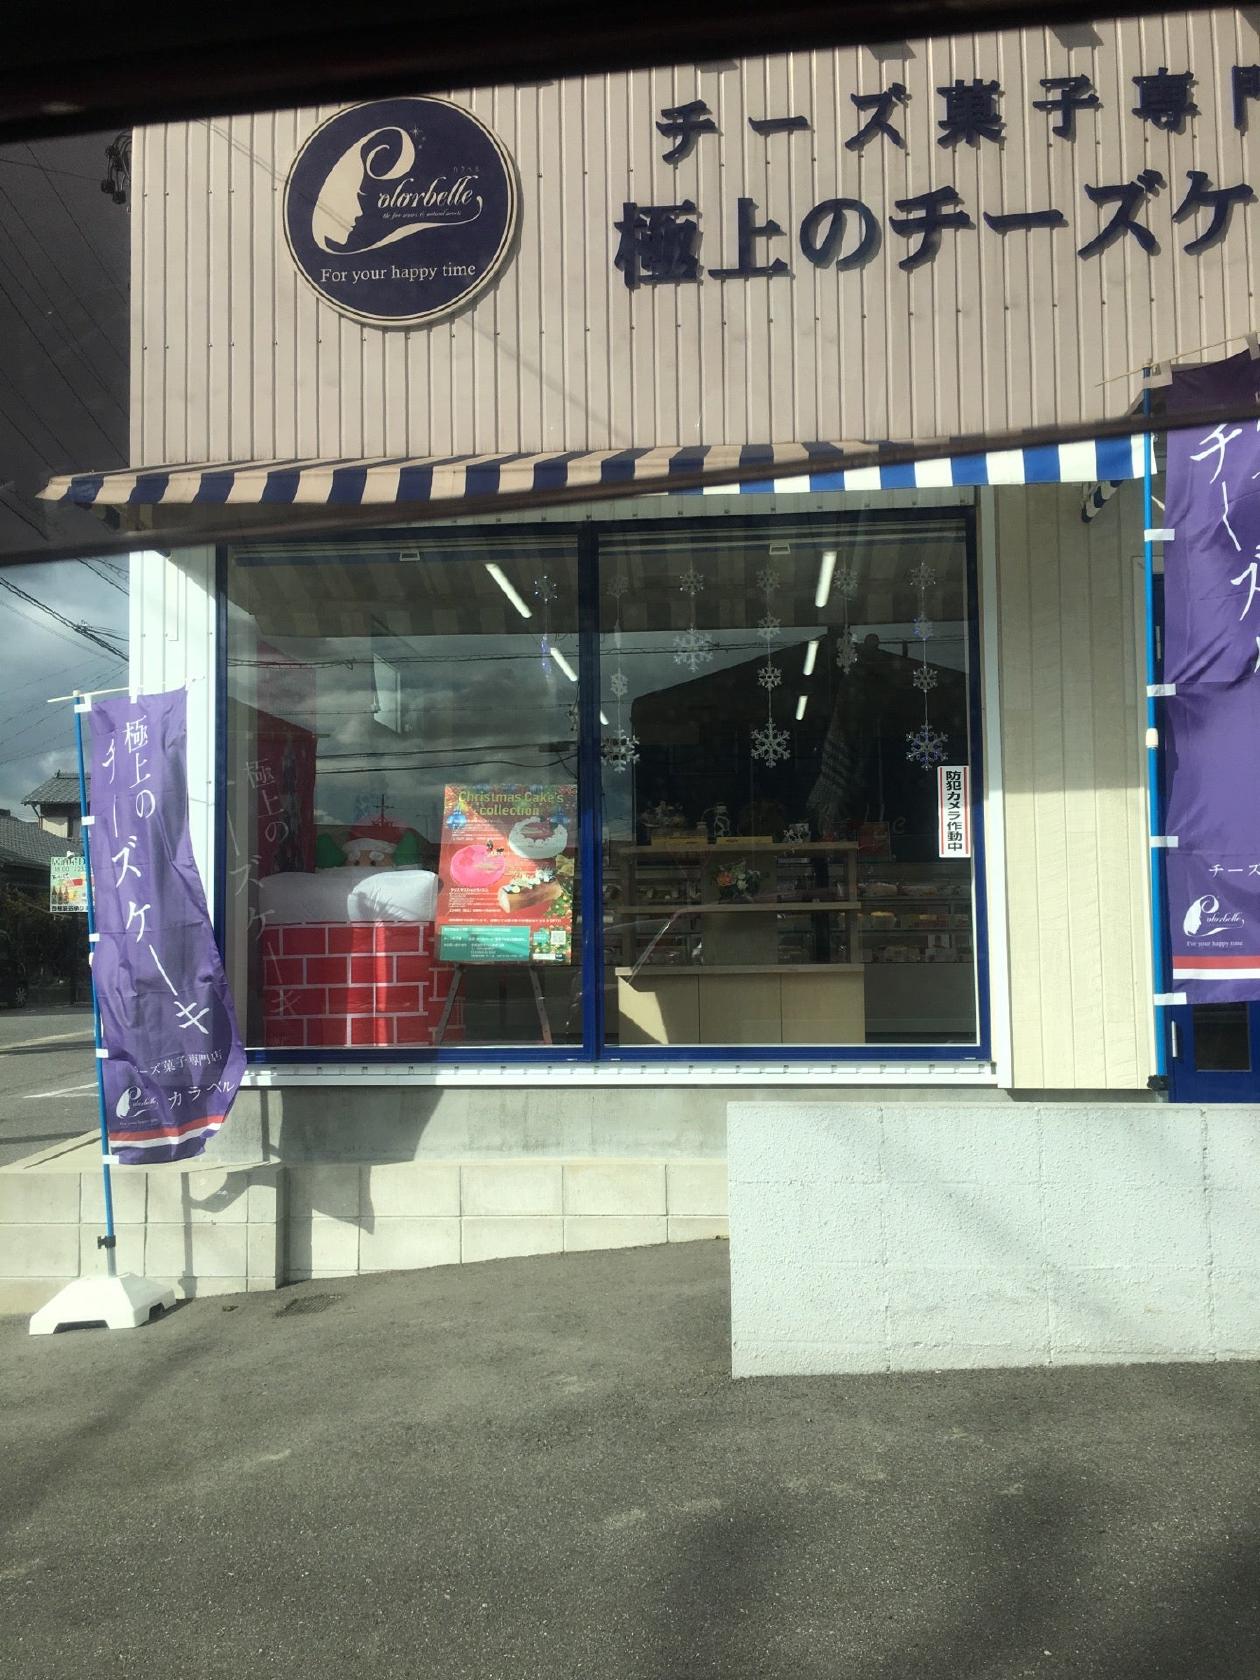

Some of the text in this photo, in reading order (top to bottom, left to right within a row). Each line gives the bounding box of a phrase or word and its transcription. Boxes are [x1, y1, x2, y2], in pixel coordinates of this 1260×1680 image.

[614, 169, 1256, 290] 極上のチーズケ
[320, 261, 476, 284] For your happy time
[120, 715, 156, 818] 極上の
[460, 790, 564, 803] Christmas Cake's
[480, 804, 540, 816] collection
[945, 770, 963, 851] 防犯カメラ作動中
[102, 738, 210, 1034] チーズケーキ
